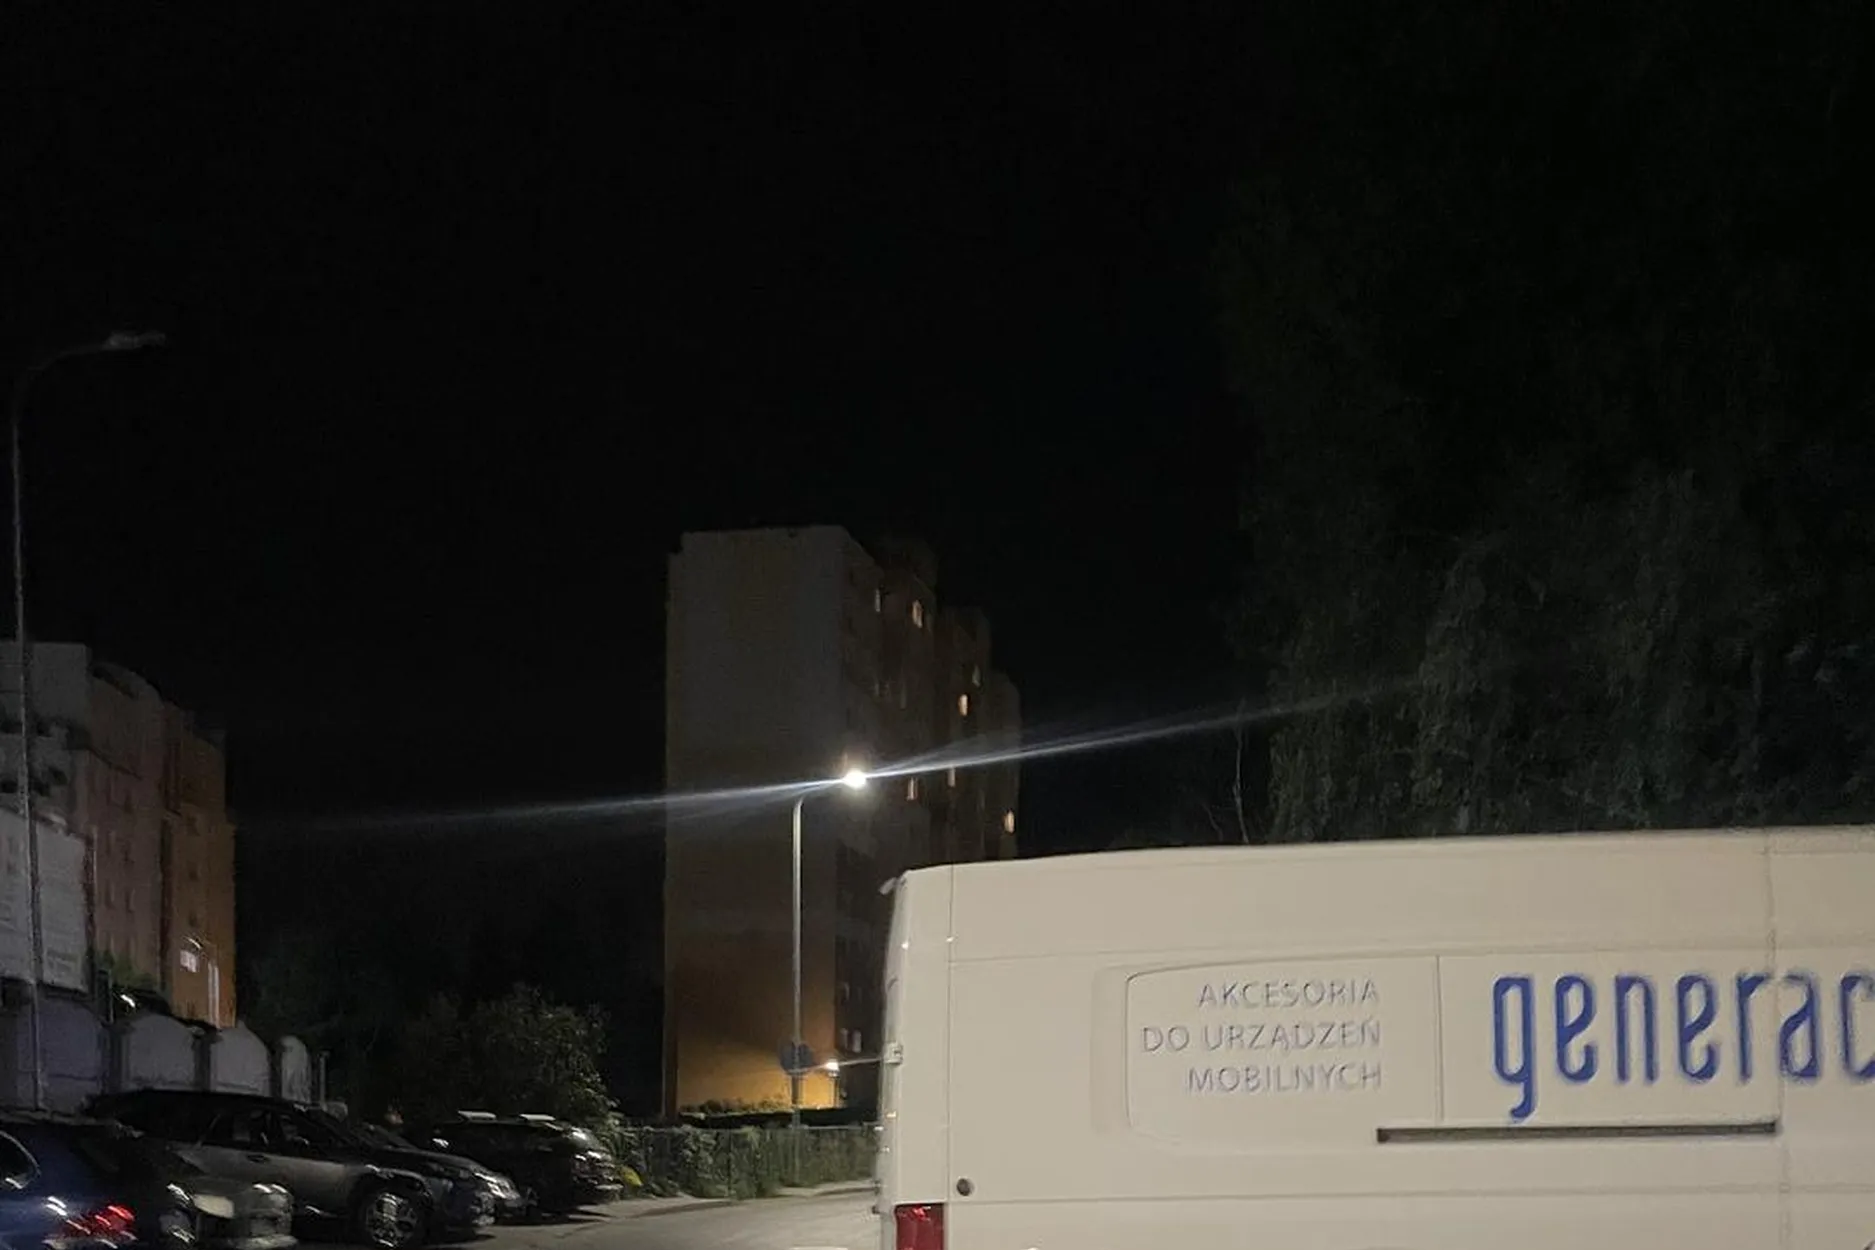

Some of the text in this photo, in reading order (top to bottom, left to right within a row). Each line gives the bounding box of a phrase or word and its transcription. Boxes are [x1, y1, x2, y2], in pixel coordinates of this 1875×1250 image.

[1198, 978, 1380, 1009] AKCESORIA
[1142, 1015, 1381, 1057] DO URZĄDZEŃ
[1187, 1062, 1382, 1094] MOBILNYCH
